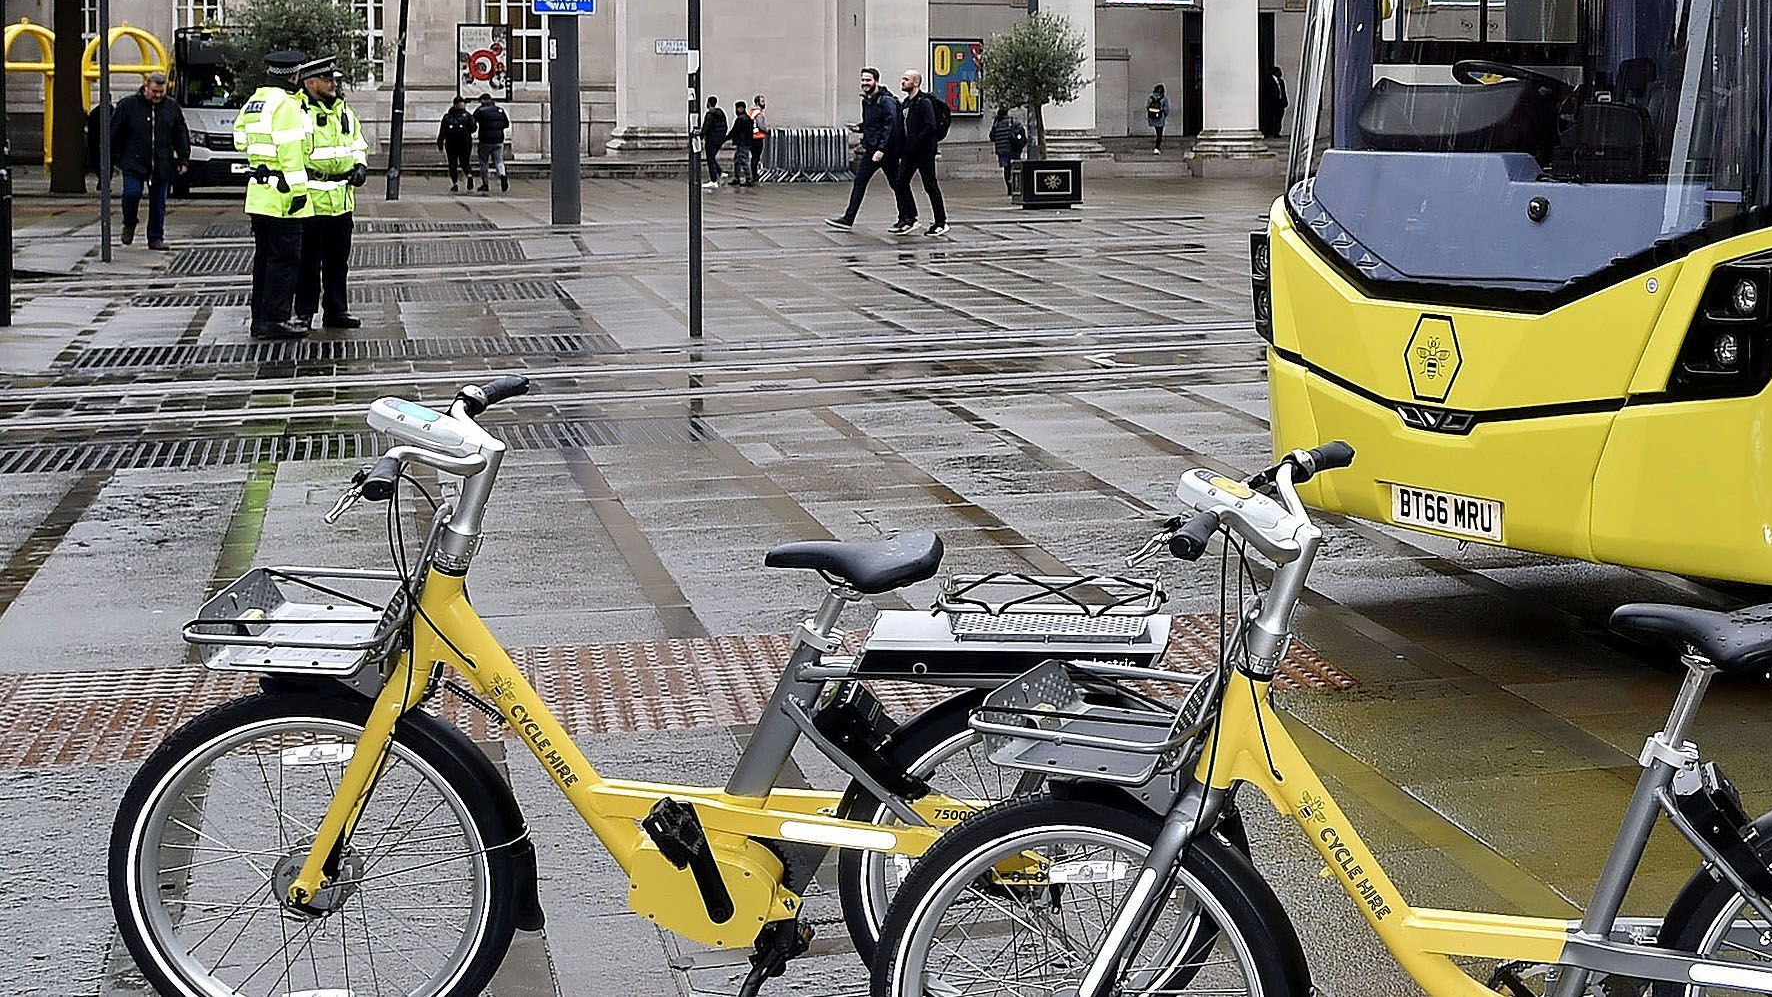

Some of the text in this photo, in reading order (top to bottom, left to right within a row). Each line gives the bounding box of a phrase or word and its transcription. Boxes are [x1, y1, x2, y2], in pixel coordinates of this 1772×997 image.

[1400, 488, 1492, 533] BT66 MRU
[510, 705, 579, 788] CYCLE HIRE
[1320, 827, 1391, 920] CYCLE HIRE
